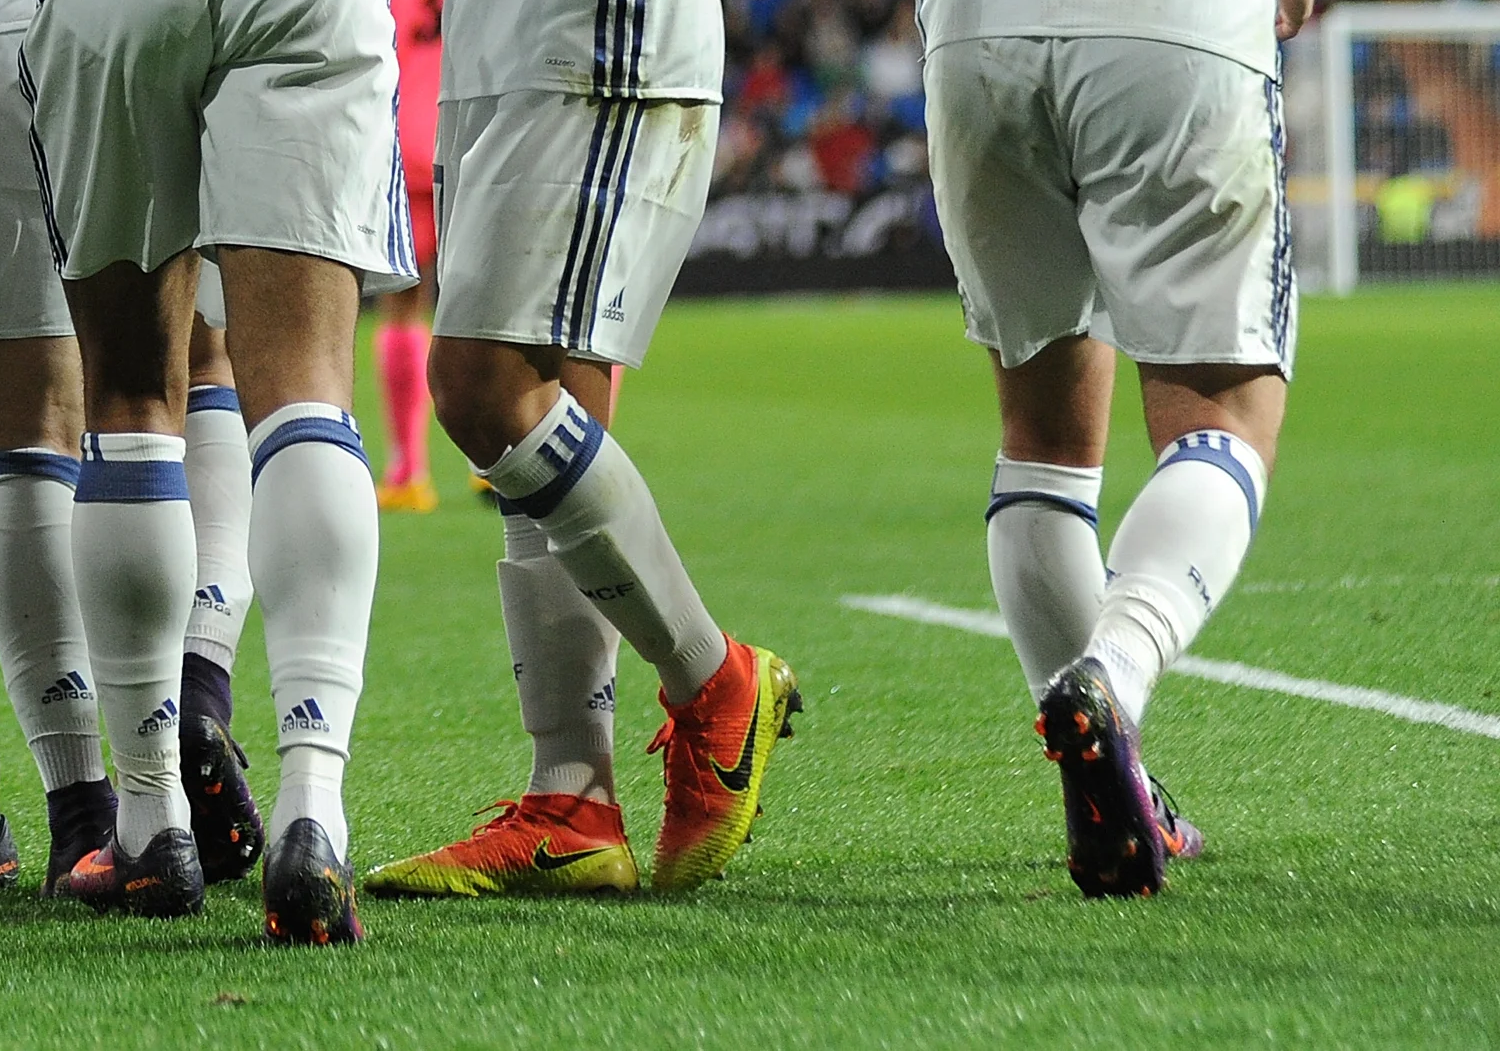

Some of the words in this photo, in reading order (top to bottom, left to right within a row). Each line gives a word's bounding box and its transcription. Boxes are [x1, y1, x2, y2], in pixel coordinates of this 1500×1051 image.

[601, 308, 625, 323] adidas
[580, 581, 636, 601] MCF
[192, 598, 231, 616] idas
[41, 688, 95, 704] adidas
[137, 717, 179, 737] adida
[280, 716, 331, 734] adidas
